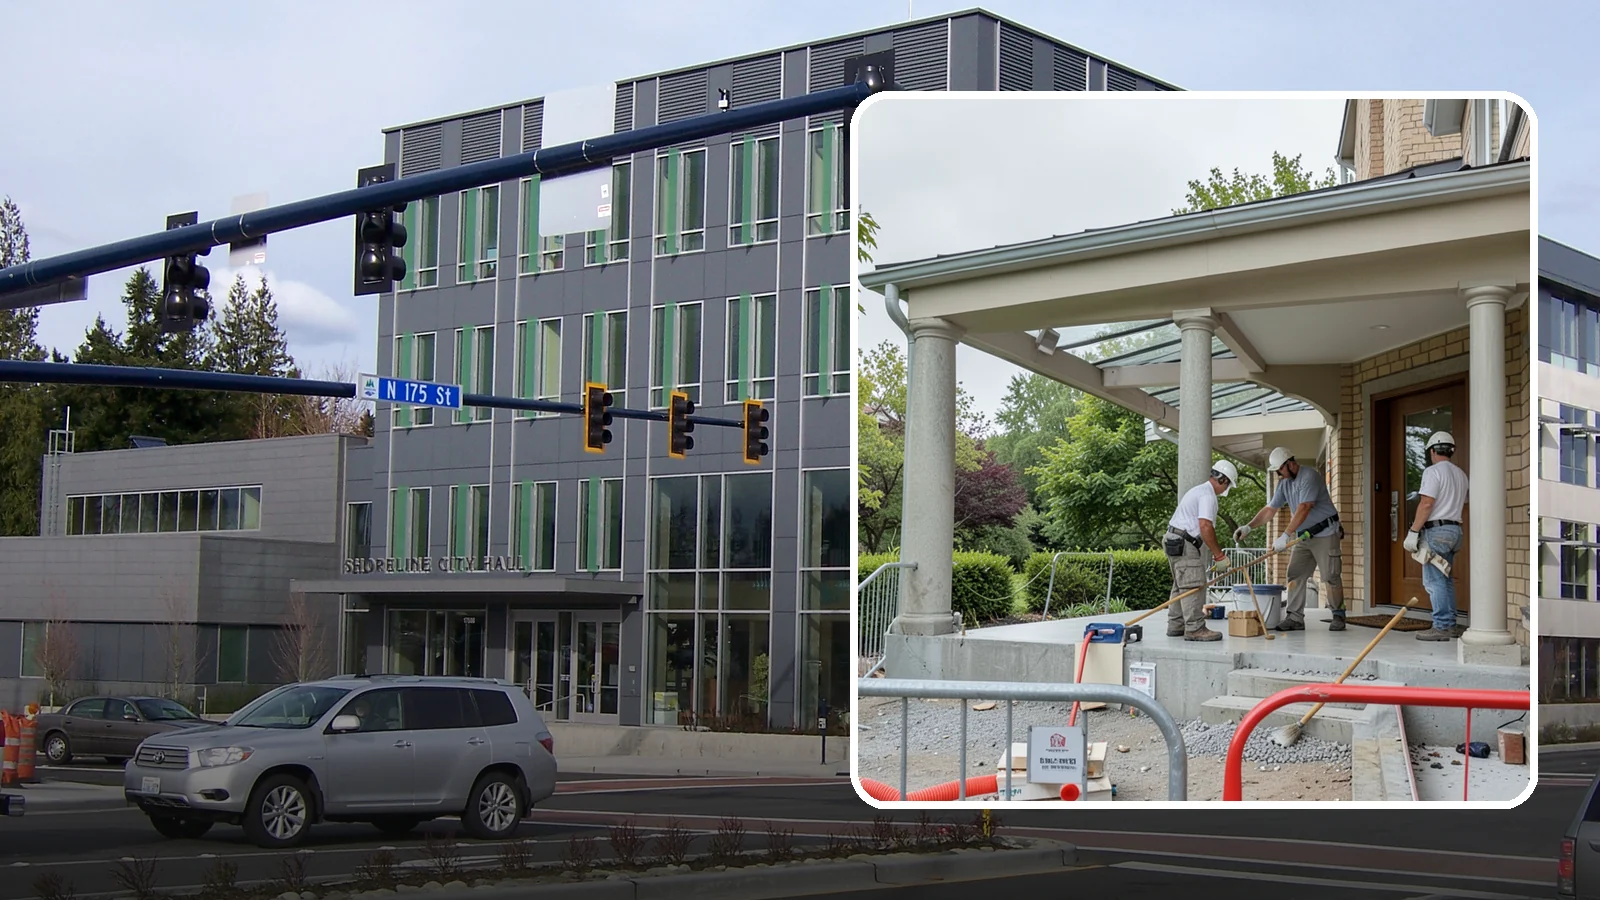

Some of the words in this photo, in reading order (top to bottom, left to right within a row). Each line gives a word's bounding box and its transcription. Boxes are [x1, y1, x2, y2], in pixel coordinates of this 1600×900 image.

[387, 380, 396, 399] N
[405, 382, 427, 403] 175
[436, 386, 451, 405] St
[344, 556, 431, 574] SHORELINE
[438, 556, 475, 573] CITY
[484, 556, 525, 572] HALL
